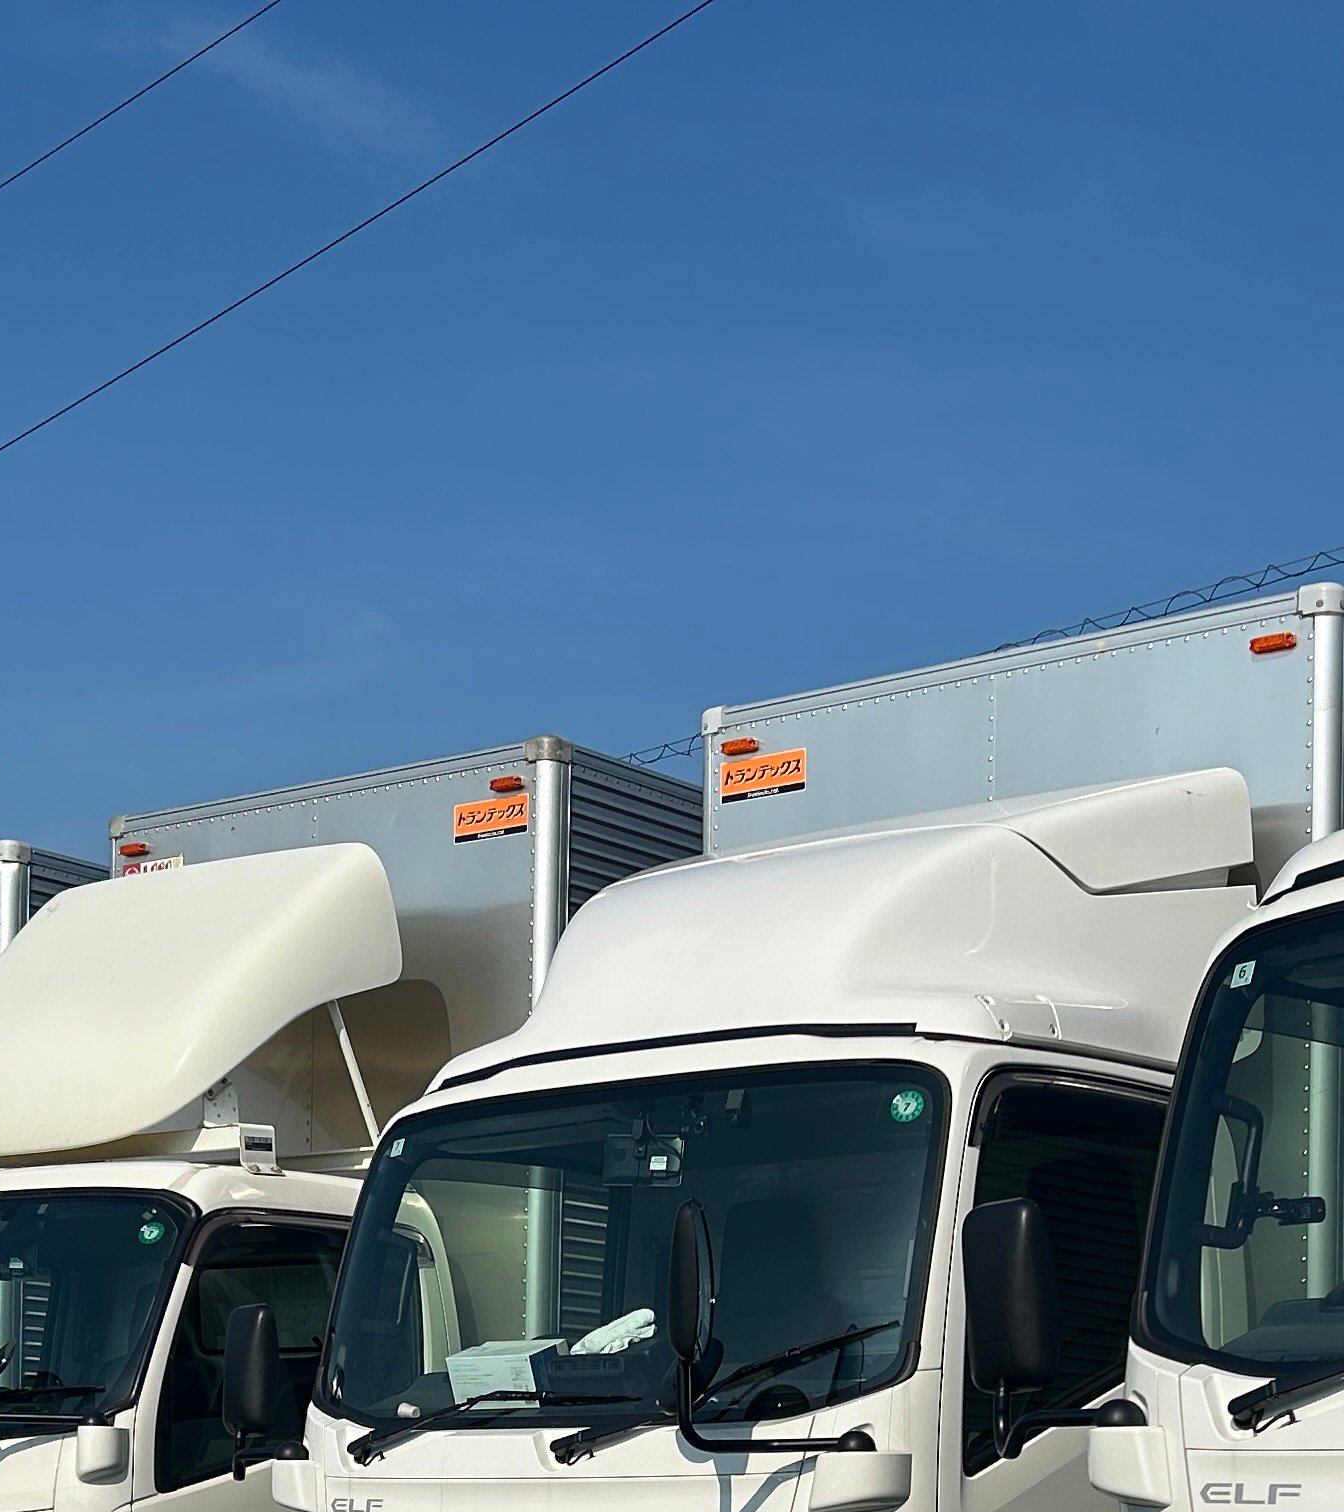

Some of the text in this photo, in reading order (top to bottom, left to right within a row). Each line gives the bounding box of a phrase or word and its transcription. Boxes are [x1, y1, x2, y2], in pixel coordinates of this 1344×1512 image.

[724, 758, 801, 786] トランテックス
[457, 803, 524, 827] トランテックス
[1239, 965, 1247, 979] 6
[903, 1103, 911, 1112] 7
[1200, 1483, 1302, 1505] ELF
[331, 1498, 384, 1512] ELF
